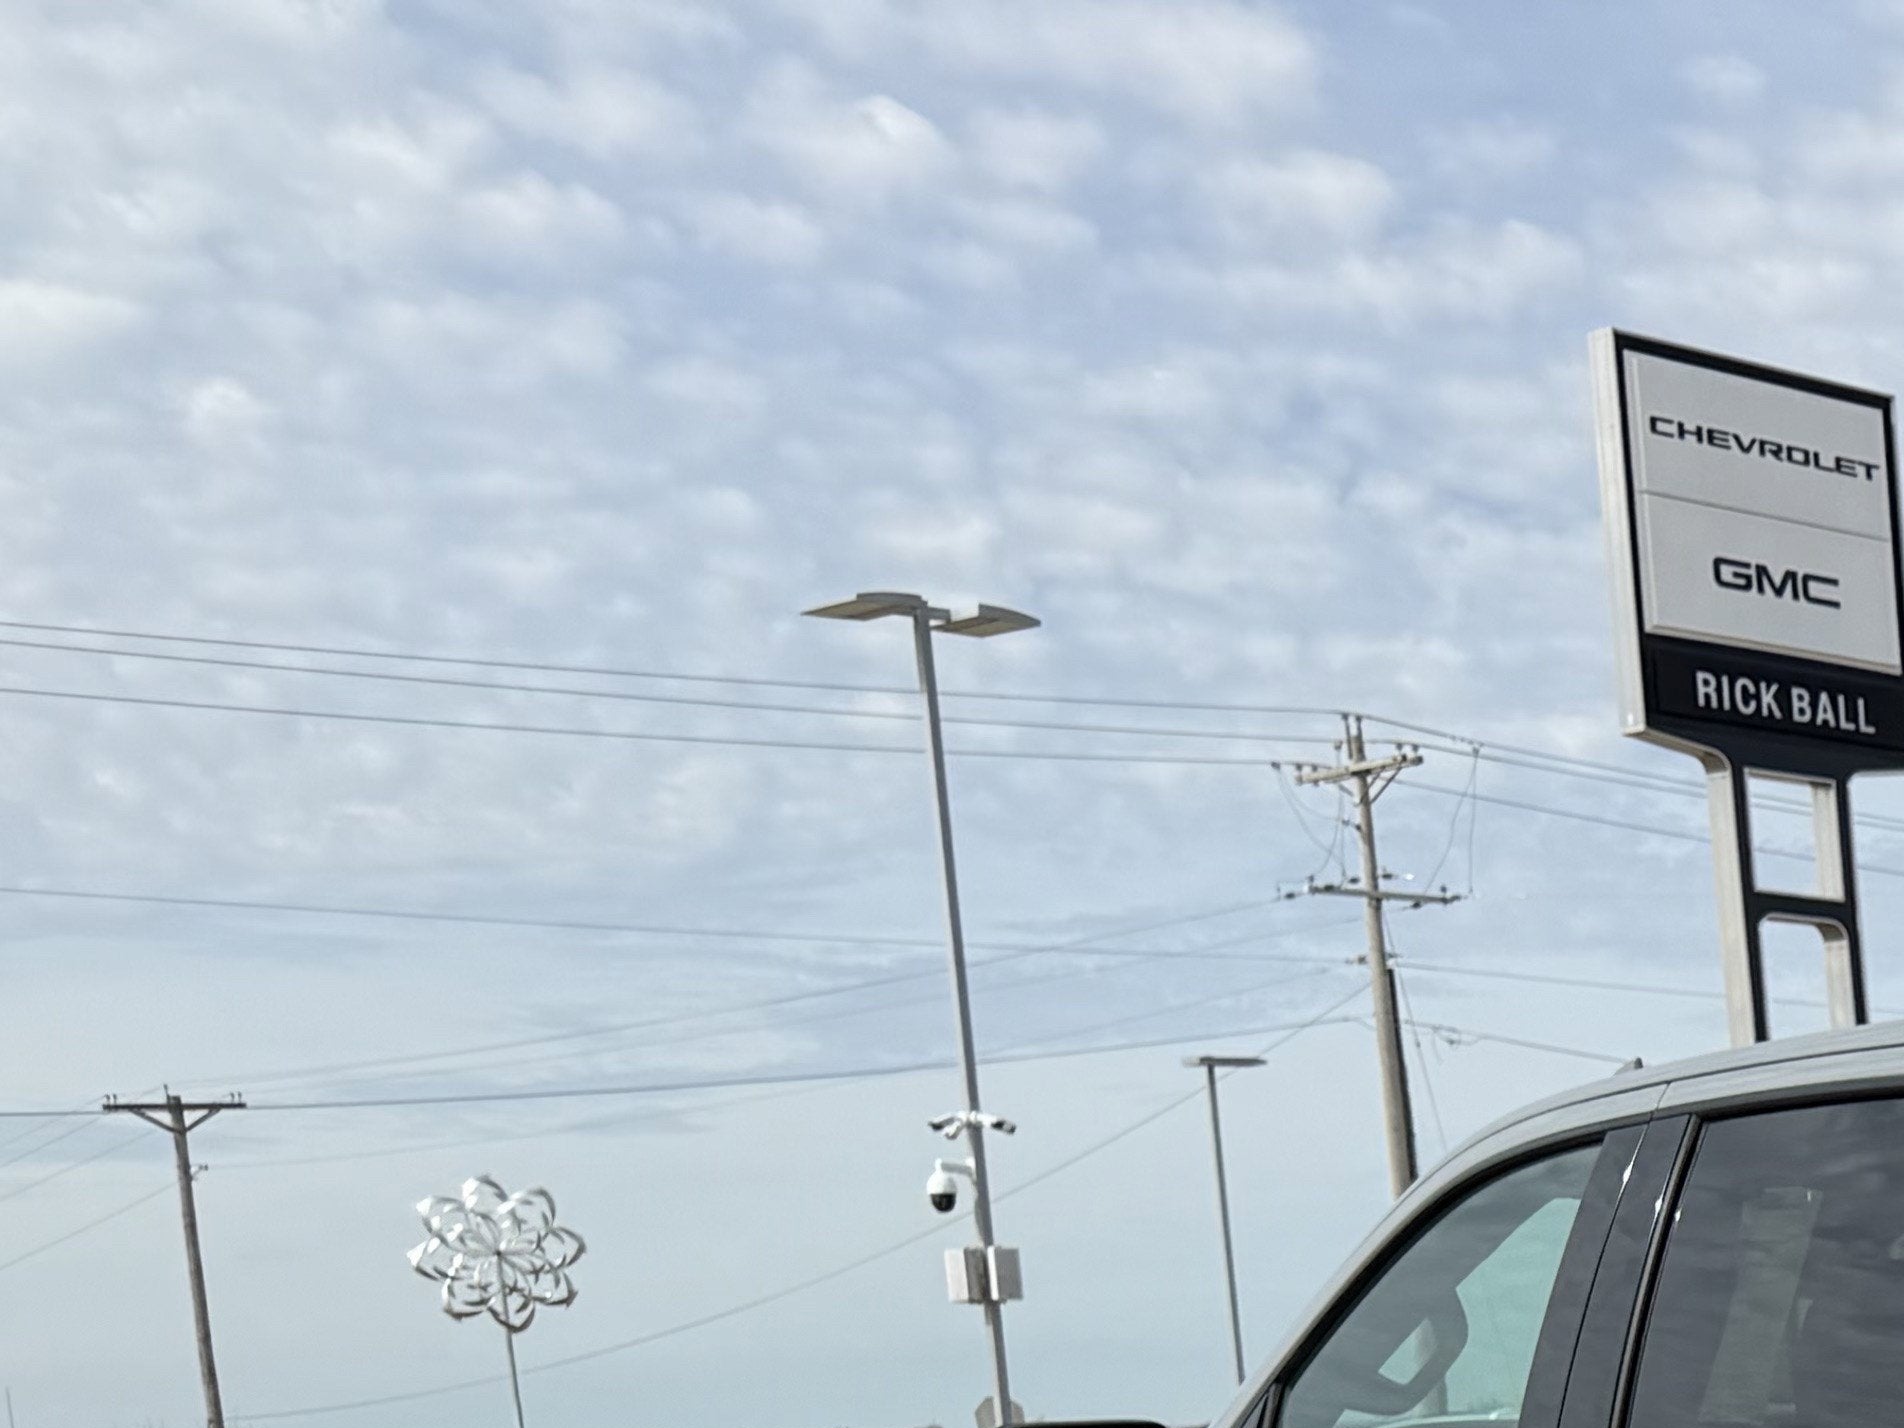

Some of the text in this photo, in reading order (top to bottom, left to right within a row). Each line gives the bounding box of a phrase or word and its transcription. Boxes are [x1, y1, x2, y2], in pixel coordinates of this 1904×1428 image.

[1649, 415, 1880, 482] CHEVROLET
[1712, 556, 1841, 610] GMC
[1695, 670, 1876, 735] RICK BALL
